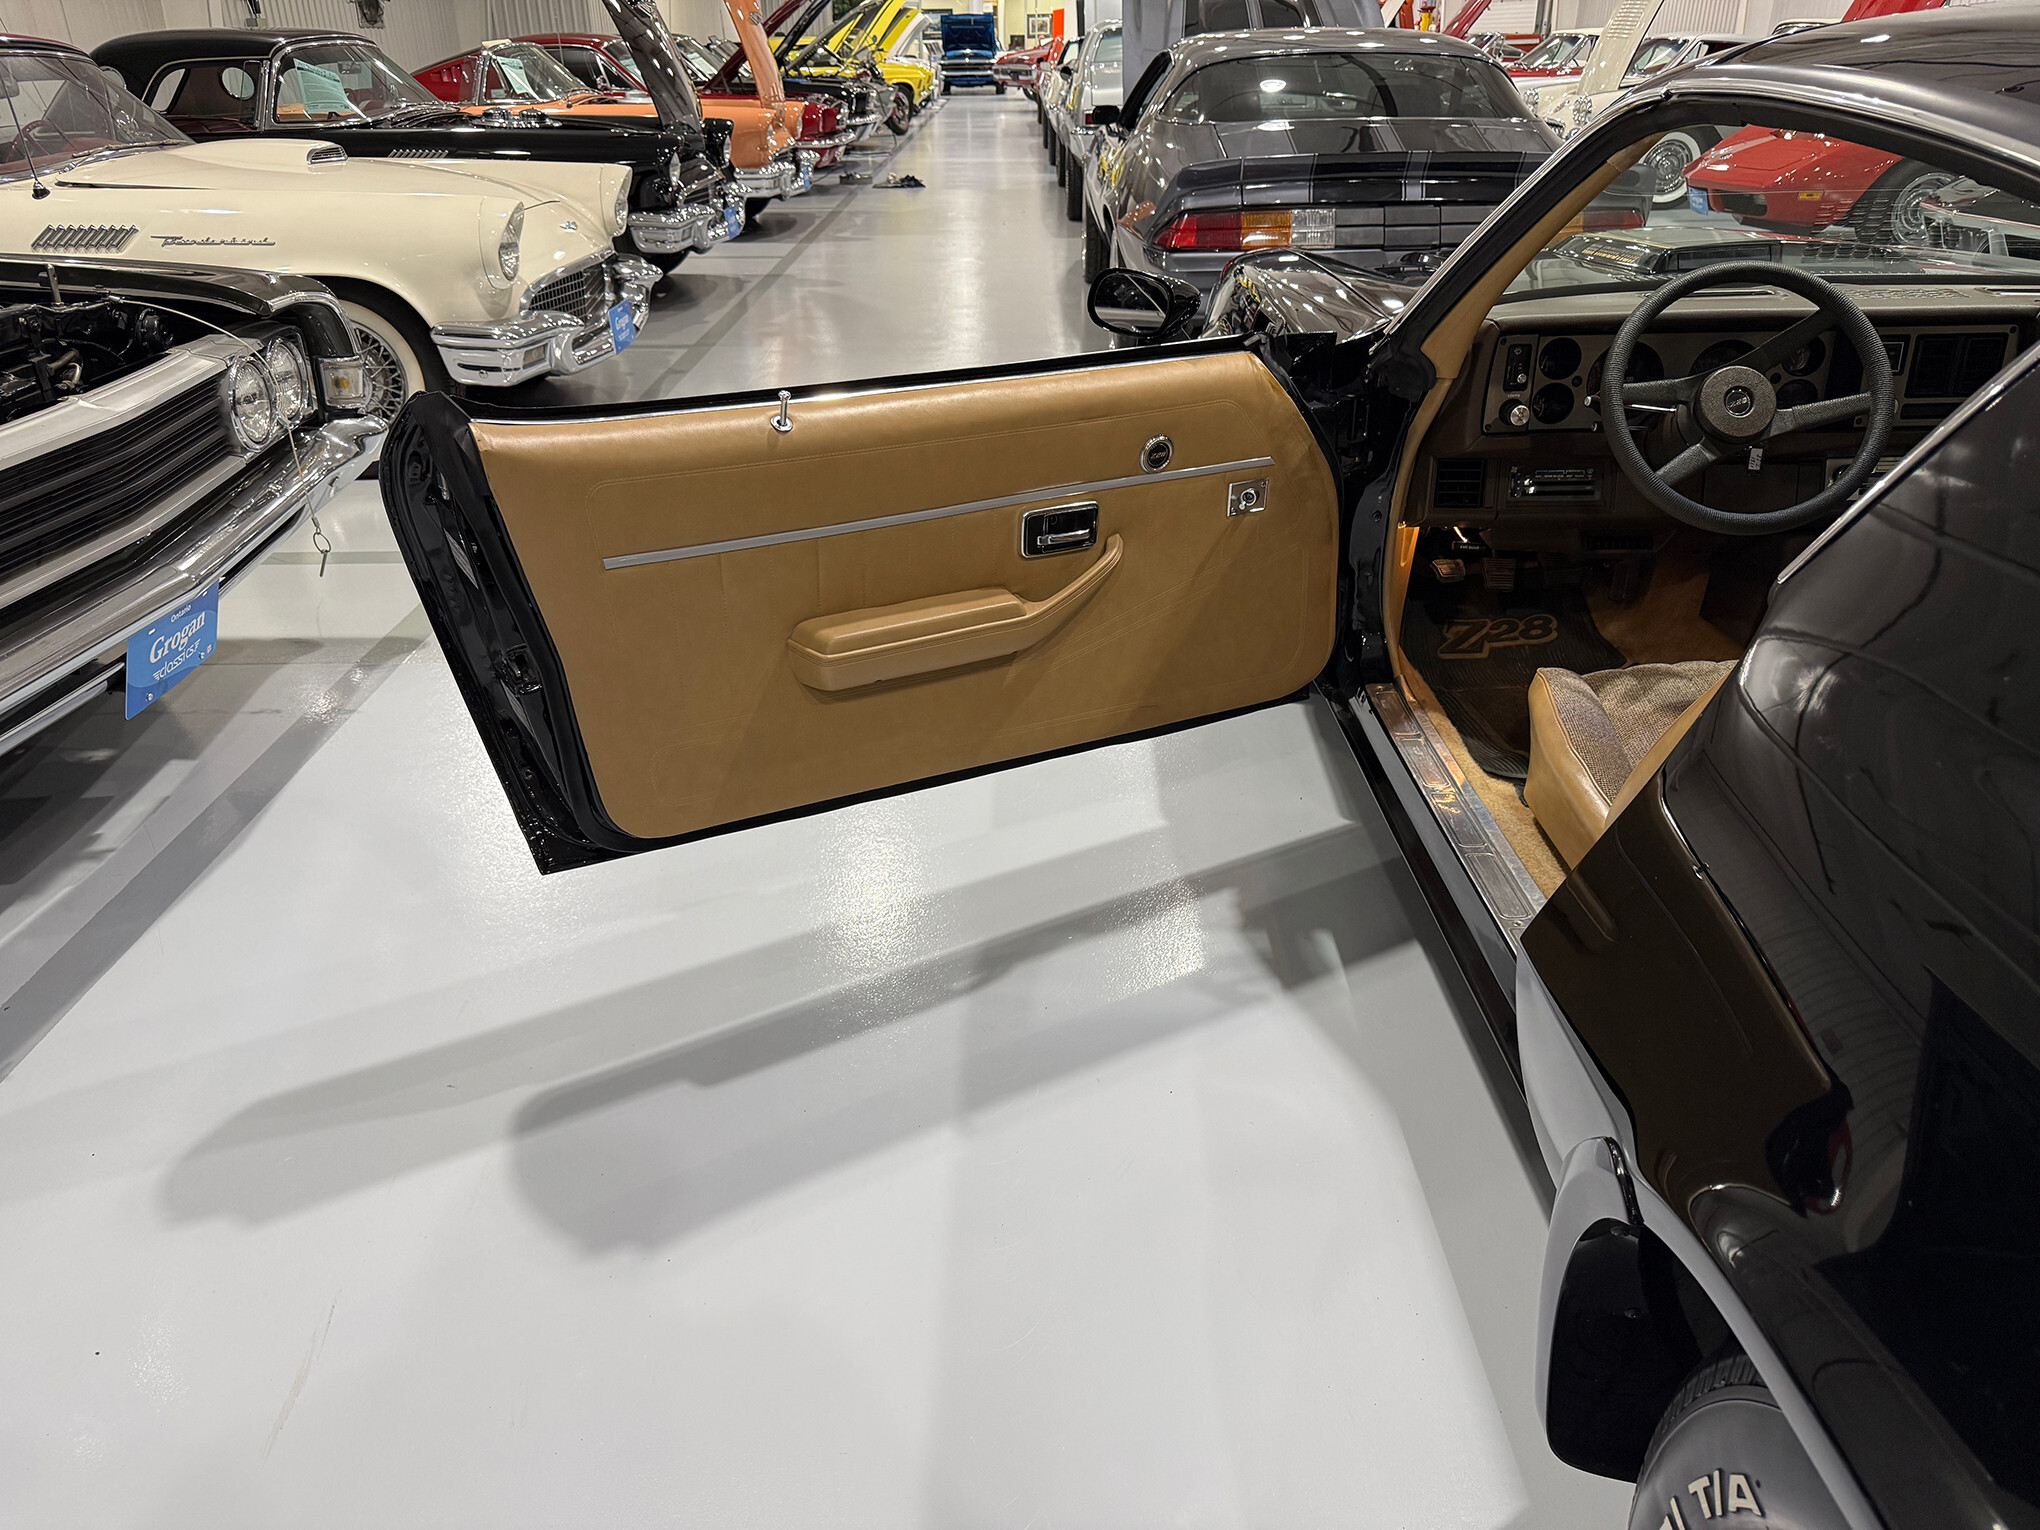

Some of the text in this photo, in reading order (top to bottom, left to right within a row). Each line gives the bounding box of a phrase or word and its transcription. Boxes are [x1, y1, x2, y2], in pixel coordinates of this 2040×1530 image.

[170, 604, 192, 623] Ontario
[1438, 613, 1558, 660] Z28
[149, 611, 206, 664] Grogan
[156, 642, 198, 679] classics
[1687, 1468, 1763, 1520] T/A
